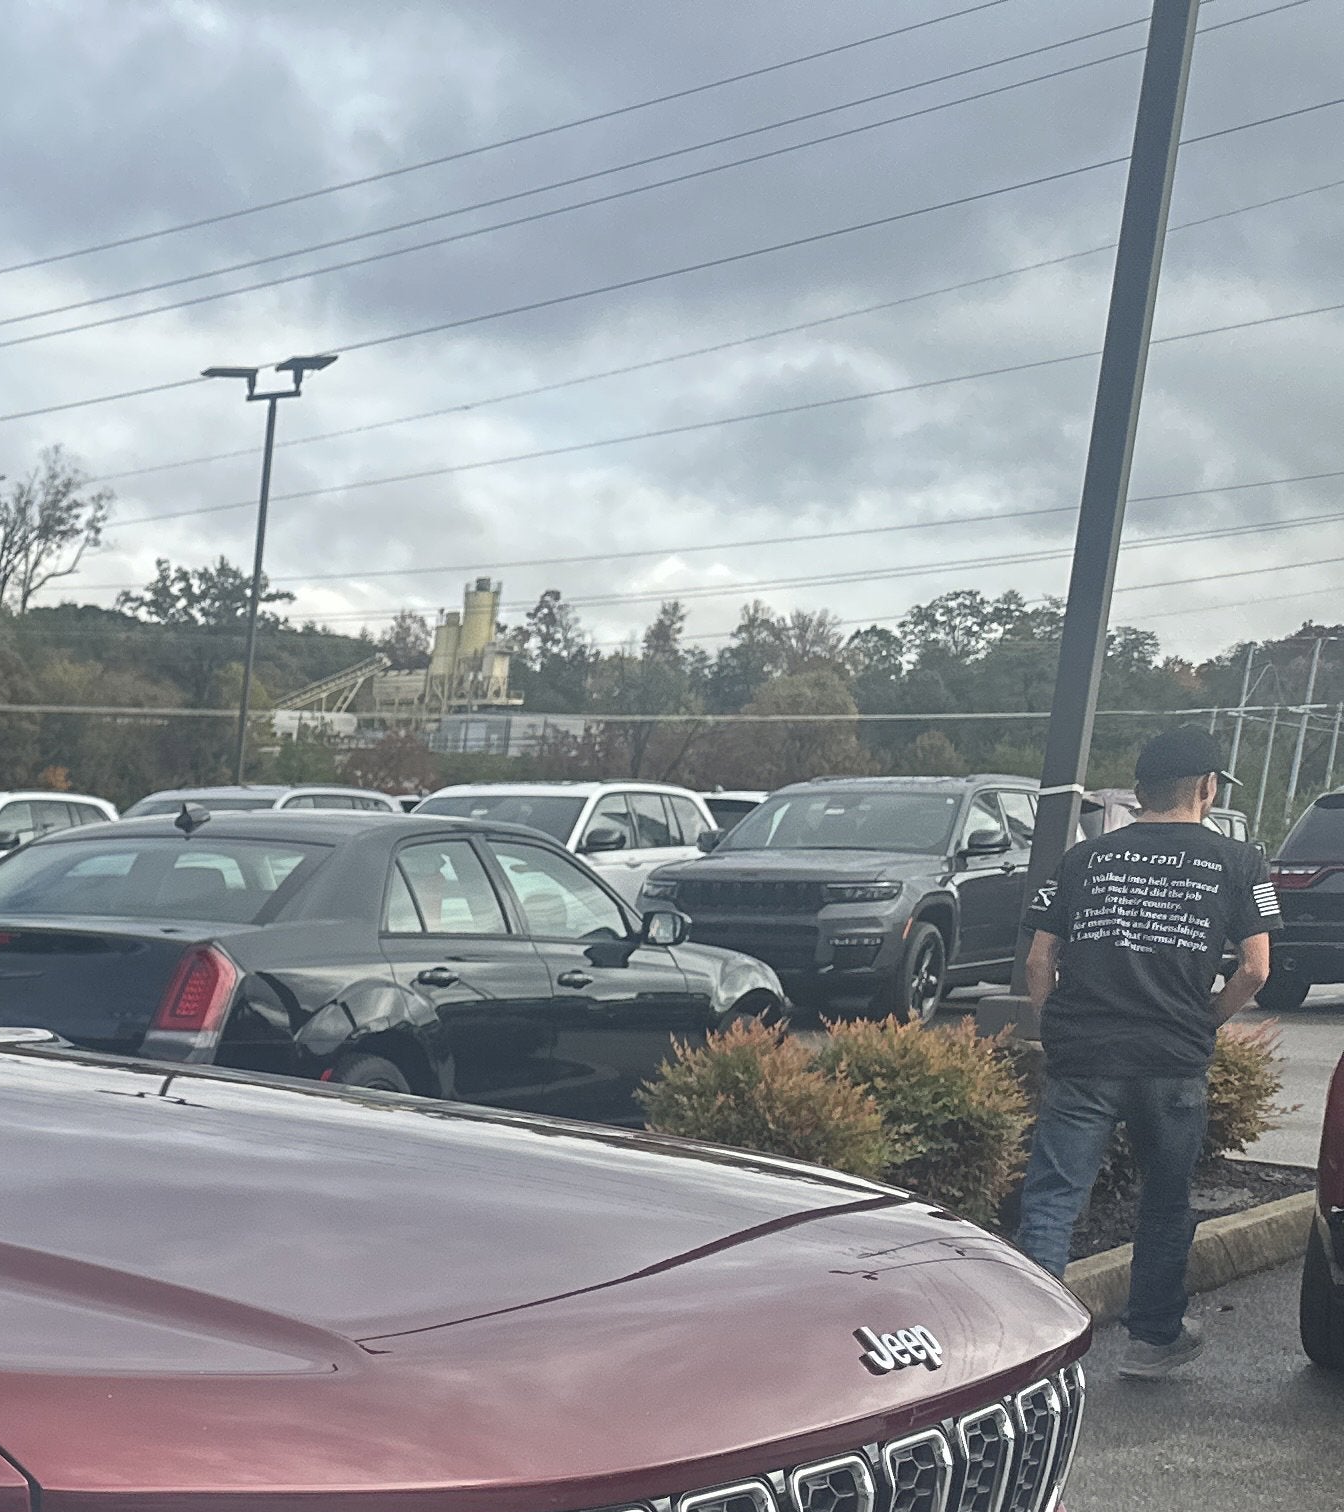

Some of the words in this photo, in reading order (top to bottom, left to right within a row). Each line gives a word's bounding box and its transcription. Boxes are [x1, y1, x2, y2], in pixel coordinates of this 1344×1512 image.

[1192, 858, 1223, 872] noun
[1091, 885, 1106, 895] the
[1130, 886, 1149, 896] and
[1149, 887, 1168, 898] did
[1168, 889, 1184, 899] the
[1184, 891, 1202, 901] job
[1127, 875, 1147, 885] into
[1148, 876, 1169, 888] hell,
[1170, 878, 1219, 893] embraced
[1083, 905, 1117, 918] Traded
[1117, 906, 1140, 917] their
[1140, 908, 1168, 921] knees
[1168, 912, 1189, 923] and
[1188, 914, 1211, 928] back
[1132, 920, 1151, 930] and
[1076, 928, 1111, 941] Laughs
[1142, 934, 1177, 945] normal
[1176, 938, 1208, 952] people
[852, 1325, 944, 1376] Jeep
